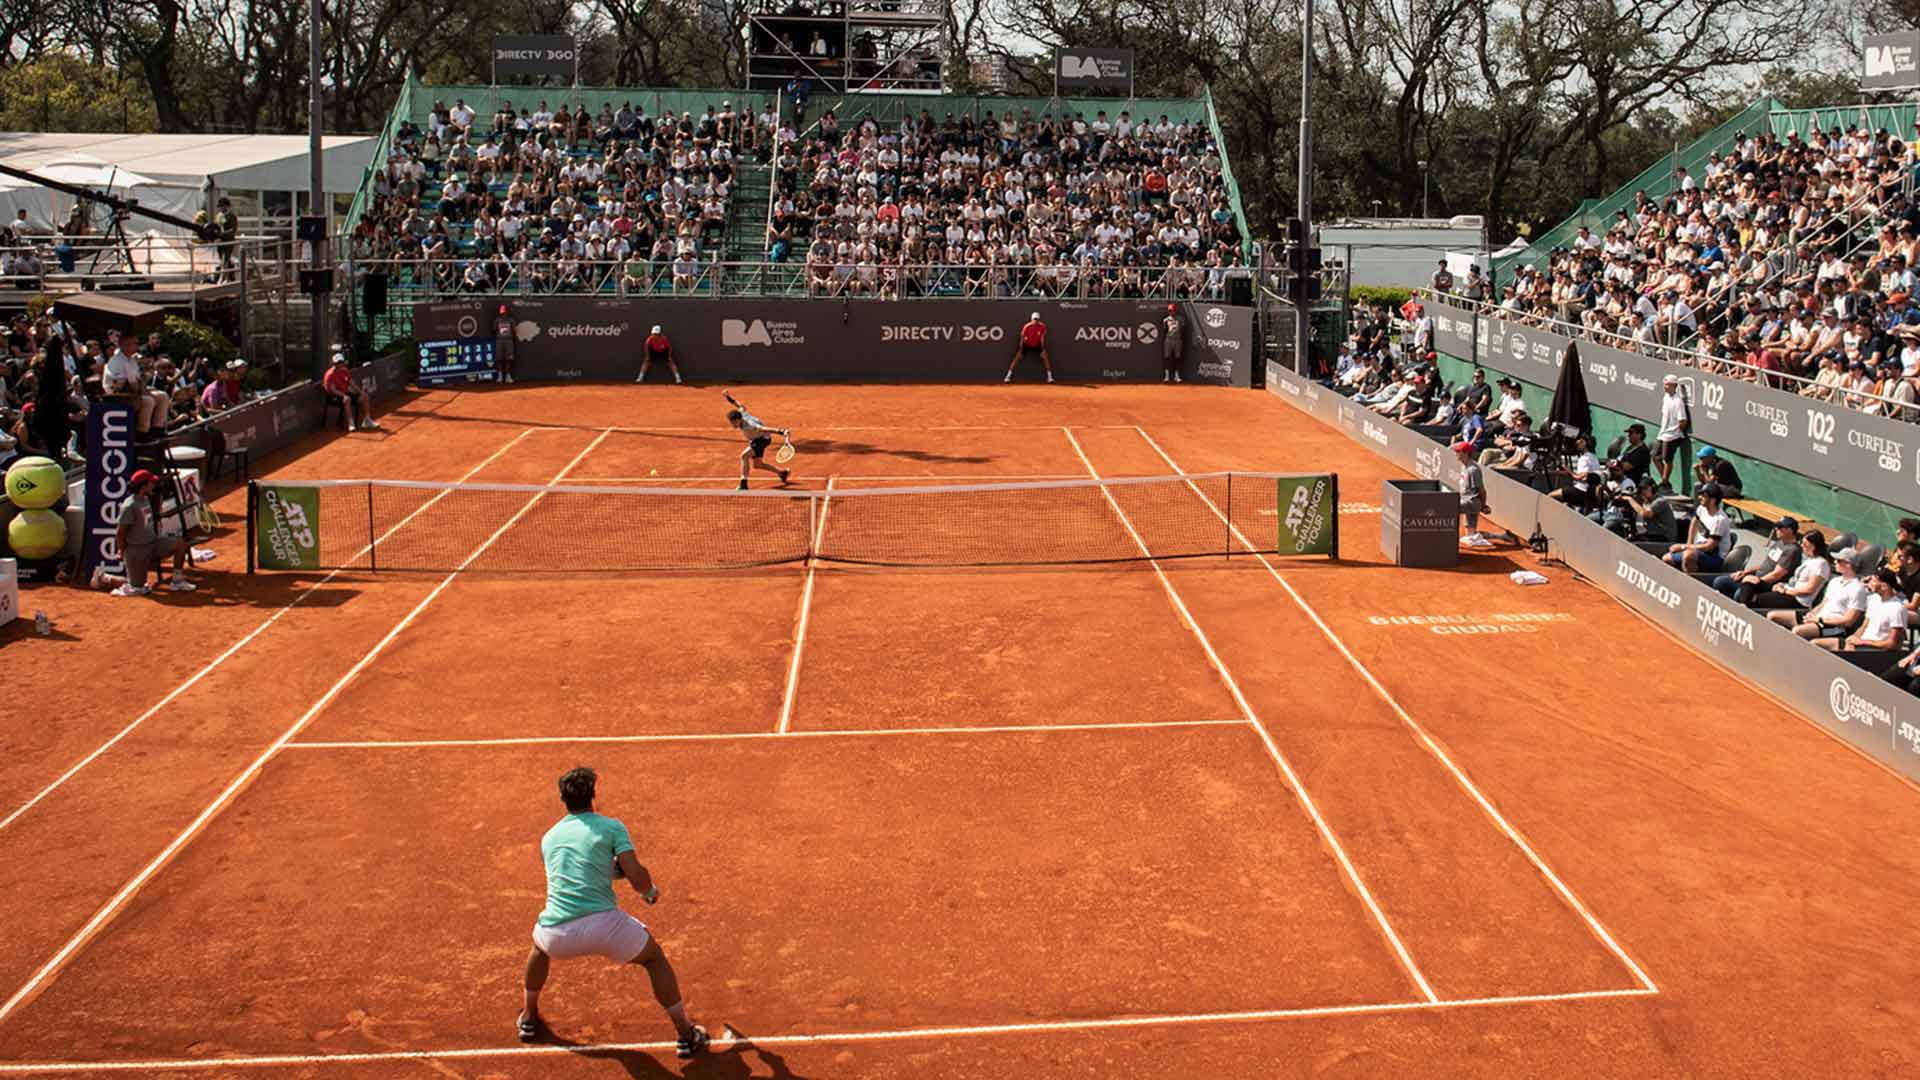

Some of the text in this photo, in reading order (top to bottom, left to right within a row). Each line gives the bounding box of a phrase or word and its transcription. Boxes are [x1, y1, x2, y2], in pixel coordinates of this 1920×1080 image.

[1062, 56, 1100, 79] BA
[548, 323, 622, 339] quicktrade
[722, 319, 772, 346] BA
[766, 321, 797, 329] Buenos
[771, 329, 795, 337] Aires
[881, 326, 1004, 341] DIRECTV DGO
[1075, 327, 1131, 341] AXION
[774, 336, 804, 344] Ciudad
[1105, 341, 1131, 349] energy
[1702, 381, 1724, 410] 102
[1745, 400, 1789, 425] CURFLEX
[1770, 422, 1788, 437] CBD
[1807, 409, 1835, 443] 102
[1848, 429, 1904, 458] CURFLEX
[1879, 454, 1902, 472] CBD
[281, 499, 315, 548] ATP
[1286, 485, 1309, 537] ATP
[1296, 480, 1326, 552] CHALLENGER
[1403, 519, 1455, 527] CAVIAHUE
[266, 490, 301, 567] CHALLENGER
[1307, 515, 1325, 545] TOUR
[267, 527, 286, 560] TOUR
[1616, 560, 1681, 608] DUNLOP
[1696, 595, 1754, 650] EXPERTA
[1850, 704, 1873, 727] OPEN
